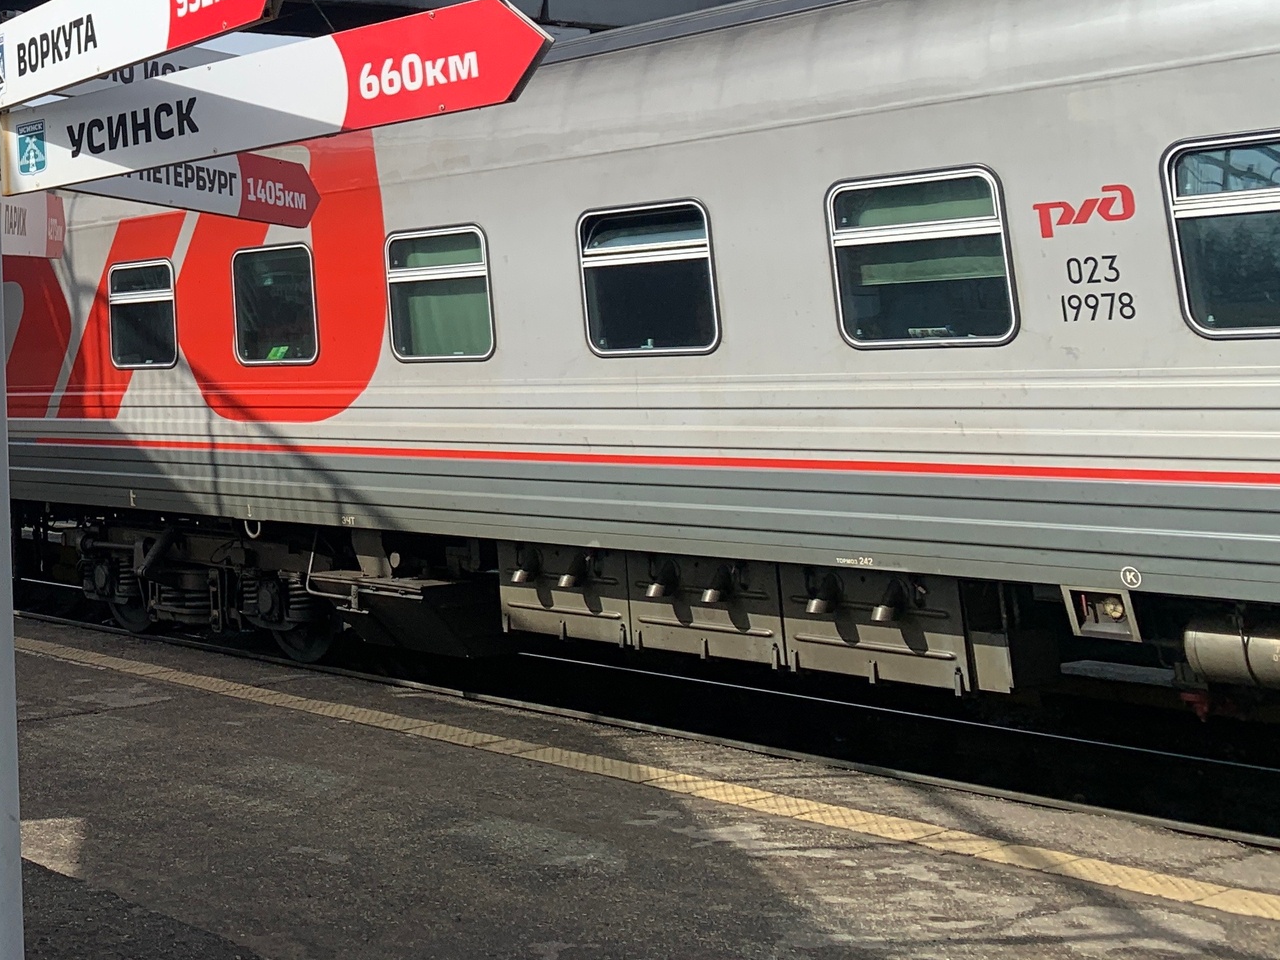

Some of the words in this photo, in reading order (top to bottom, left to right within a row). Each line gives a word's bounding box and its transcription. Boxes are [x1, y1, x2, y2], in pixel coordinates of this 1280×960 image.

[17, 13, 98, 76] ВОРКУТА
[67, 97, 199, 158] УСИНСК
[359, 50, 478, 99] 660км
[247, 178, 307, 210] 1405км
[4, 204, 27, 236] ПАРИЖ
[1066, 255, 1120, 284] 023
[1061, 292, 1136, 322] 19978
